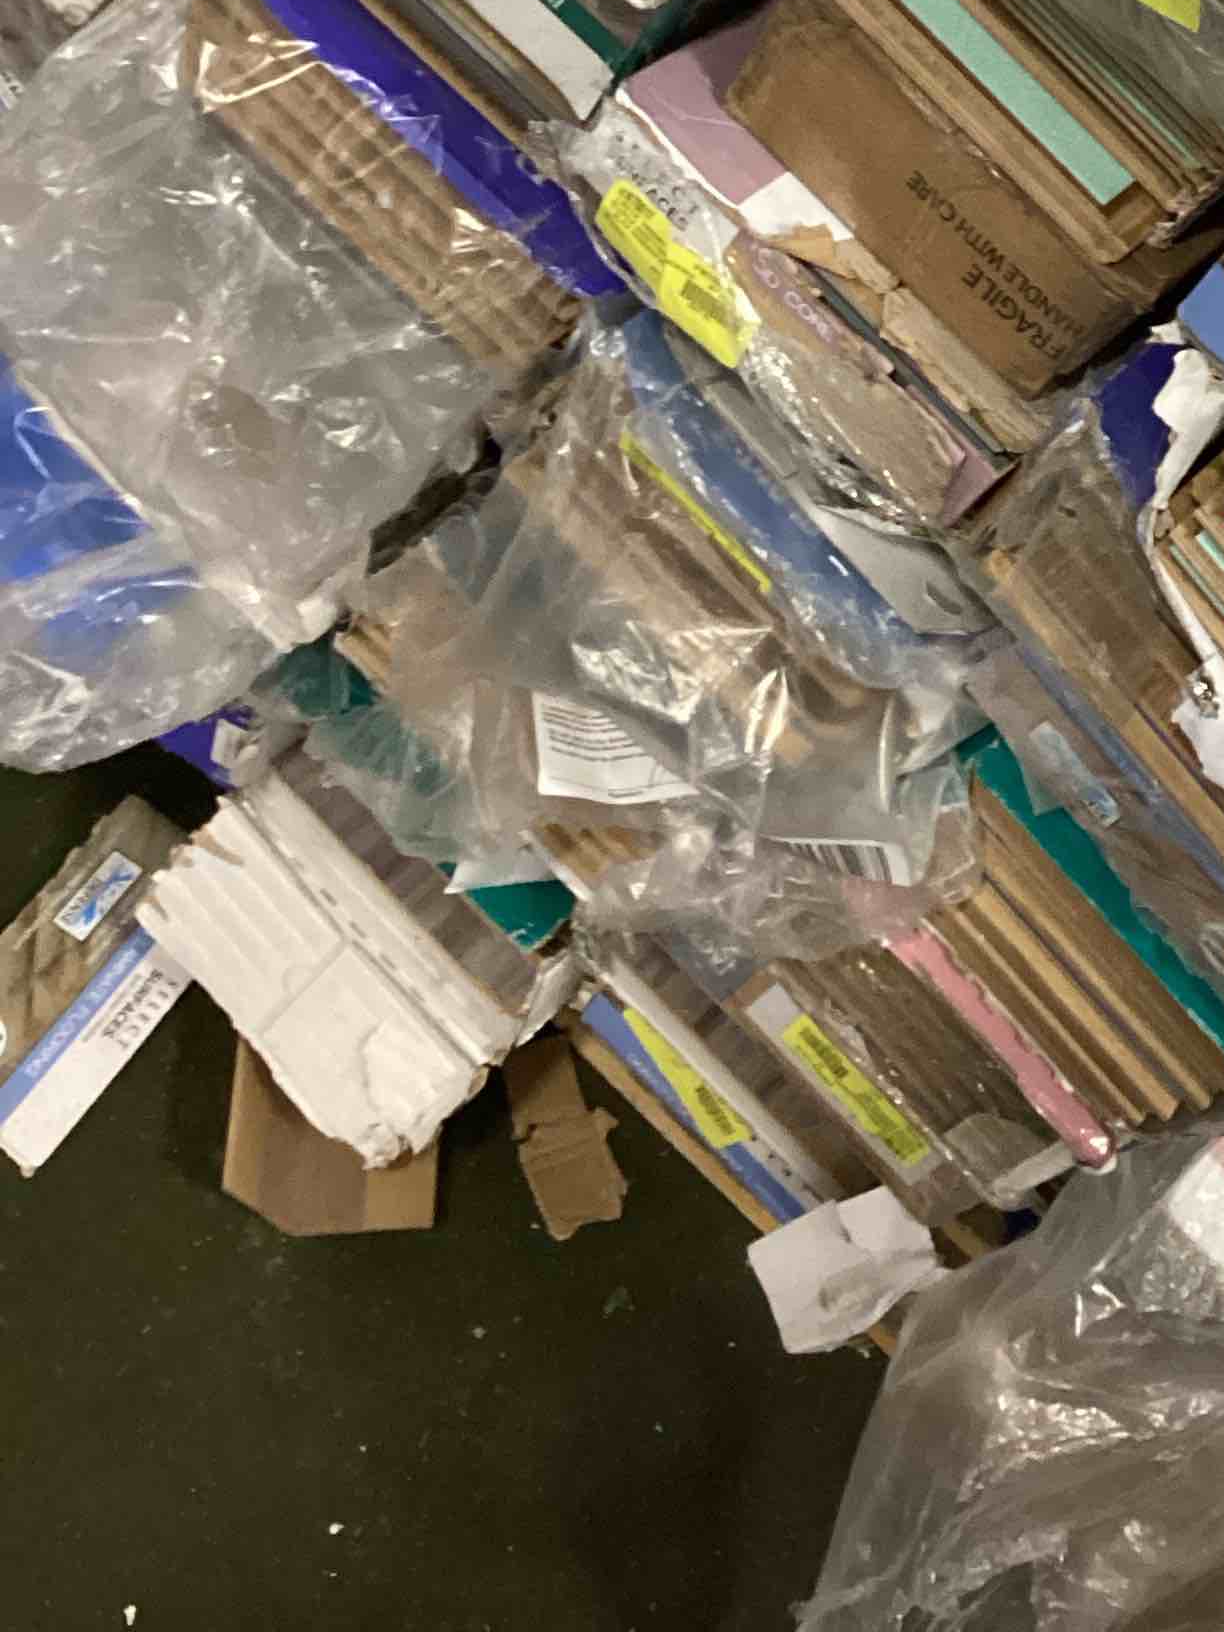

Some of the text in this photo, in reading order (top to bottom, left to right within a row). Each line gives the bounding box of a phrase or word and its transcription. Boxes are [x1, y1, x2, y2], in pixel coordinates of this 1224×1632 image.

[905, 170, 1086, 339] HANDLE WITH CARE
[959, 265, 1067, 361] FRAGILE
